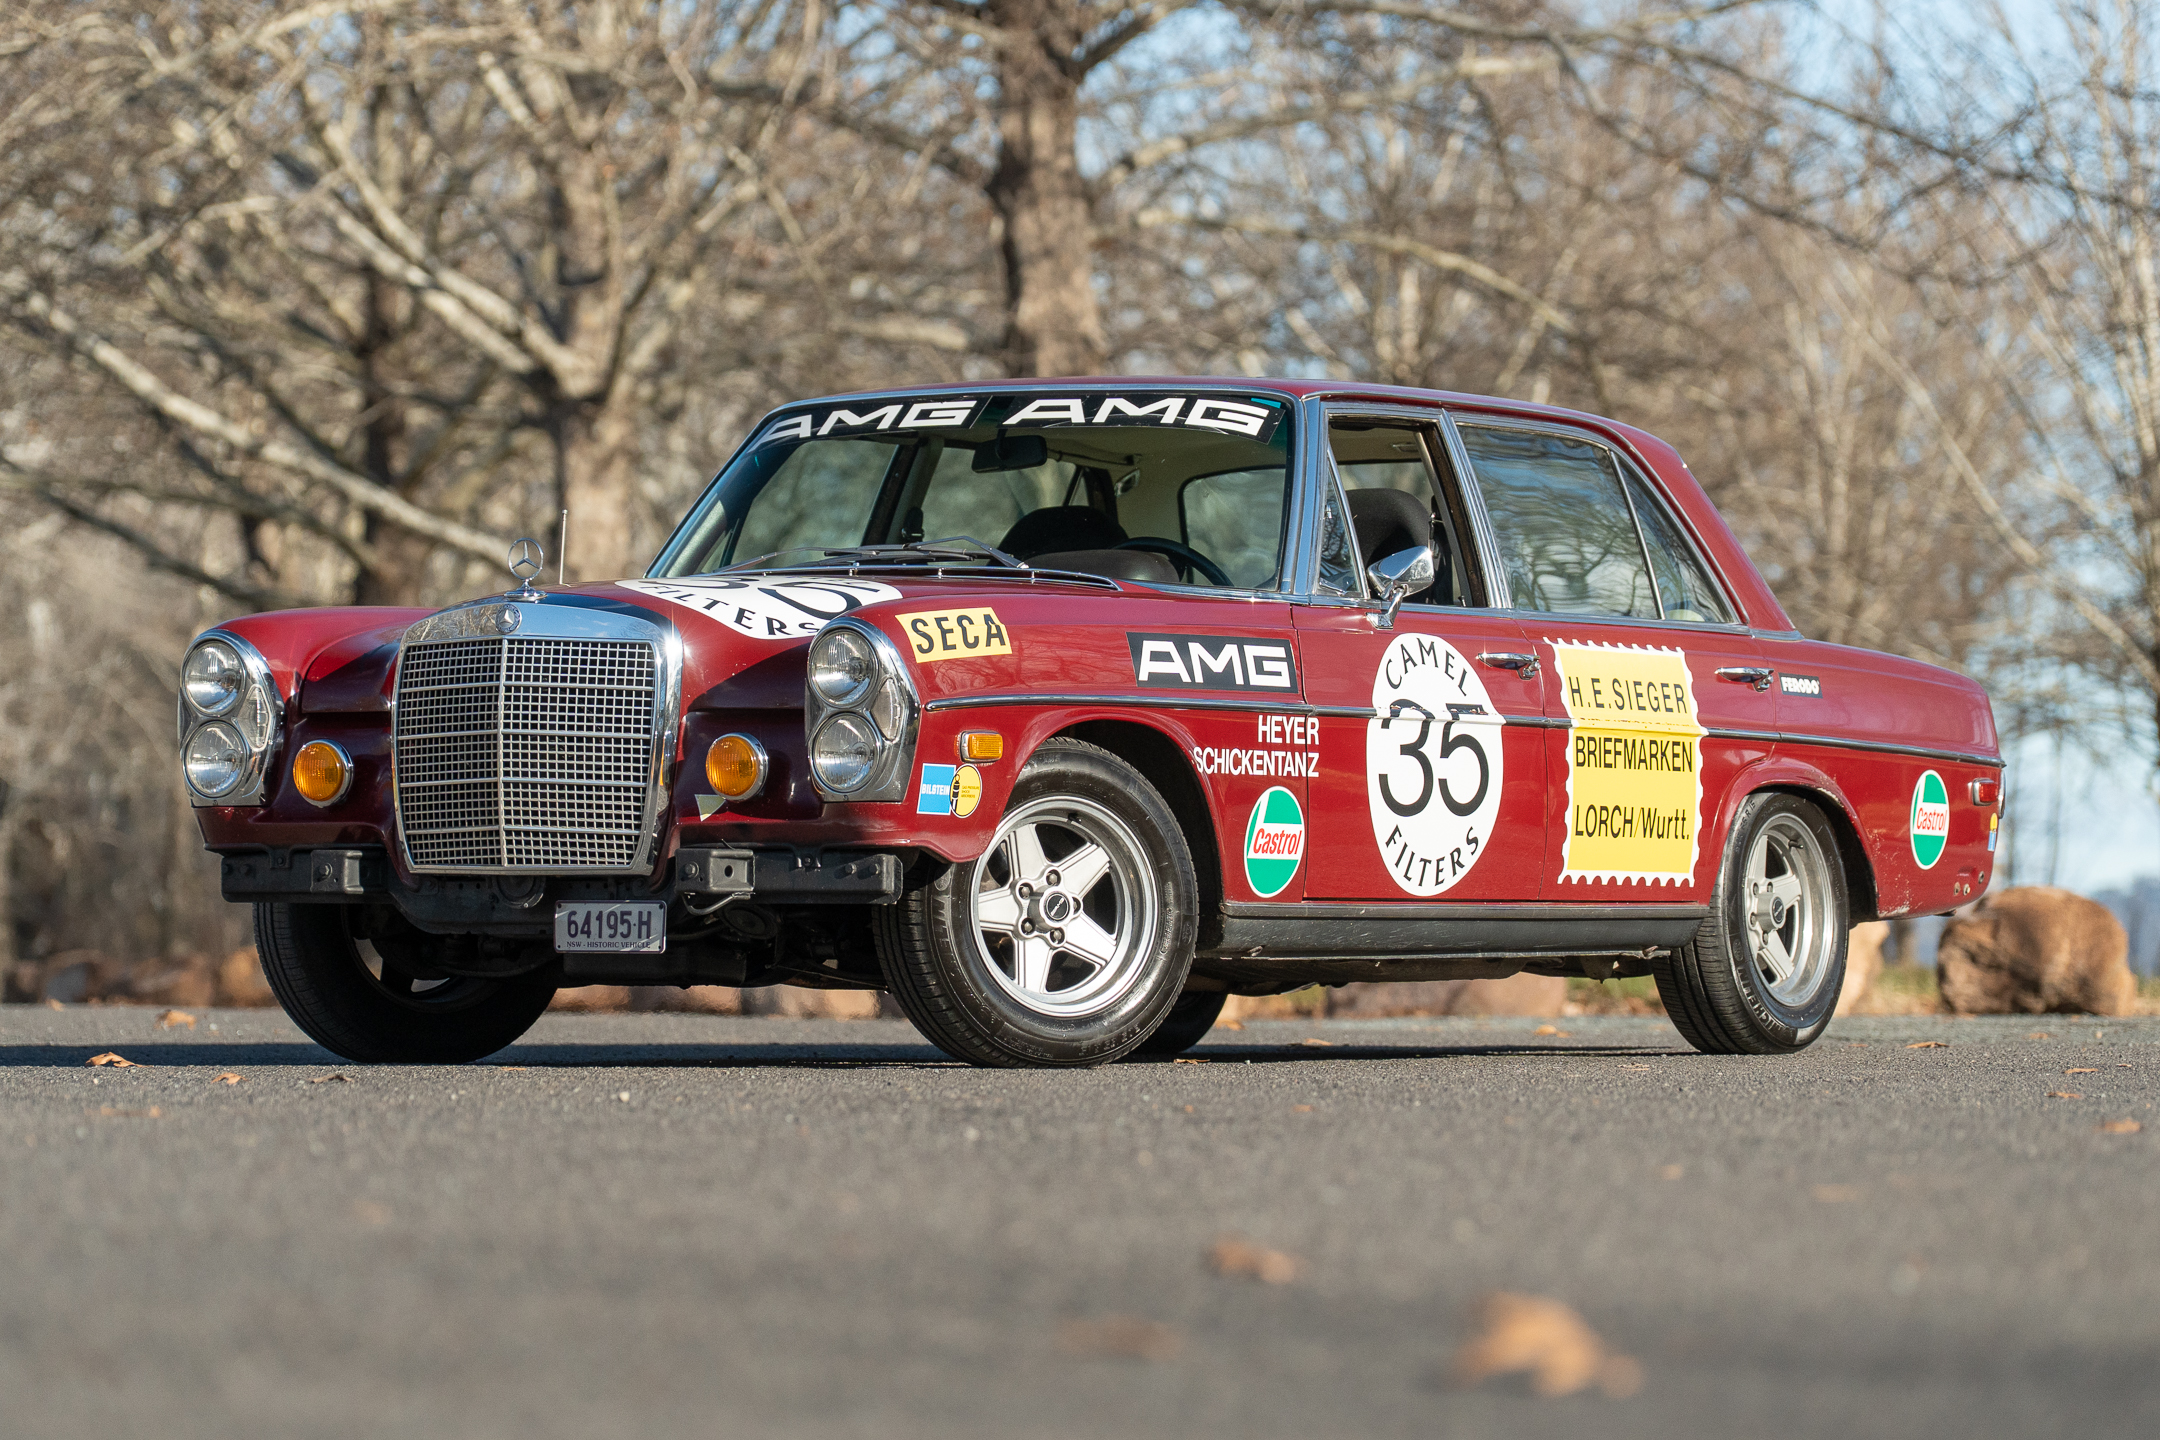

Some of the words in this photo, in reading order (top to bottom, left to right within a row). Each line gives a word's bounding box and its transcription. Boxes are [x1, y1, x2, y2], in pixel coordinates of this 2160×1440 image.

[747, 400, 977, 453] AMG
[1002, 397, 1269, 436] AMG
[911, 613, 1006, 654] SECA
[1138, 639, 1291, 688] AMG
[1385, 637, 1467, 696] CAMEL
[1257, 714, 1320, 745] HEYER
[1193, 746, 1320, 778] SCHICKENTANZ
[1378, 698, 1489, 817] 35
[1575, 736, 1693, 773] BRIEFMARKEN
[921, 783, 951, 796] BILSTEIN
[1575, 803, 1690, 840] LORCH/Wurtt.
[1916, 807, 1947, 831] Castrol
[1253, 828, 1302, 855] Castrol
[1385, 824, 1479, 887] FILTERS
[566, 941, 582, 949] NSW
[587, 941, 619, 949] HISTORIC
[621, 941, 651, 949] VEHICLE
